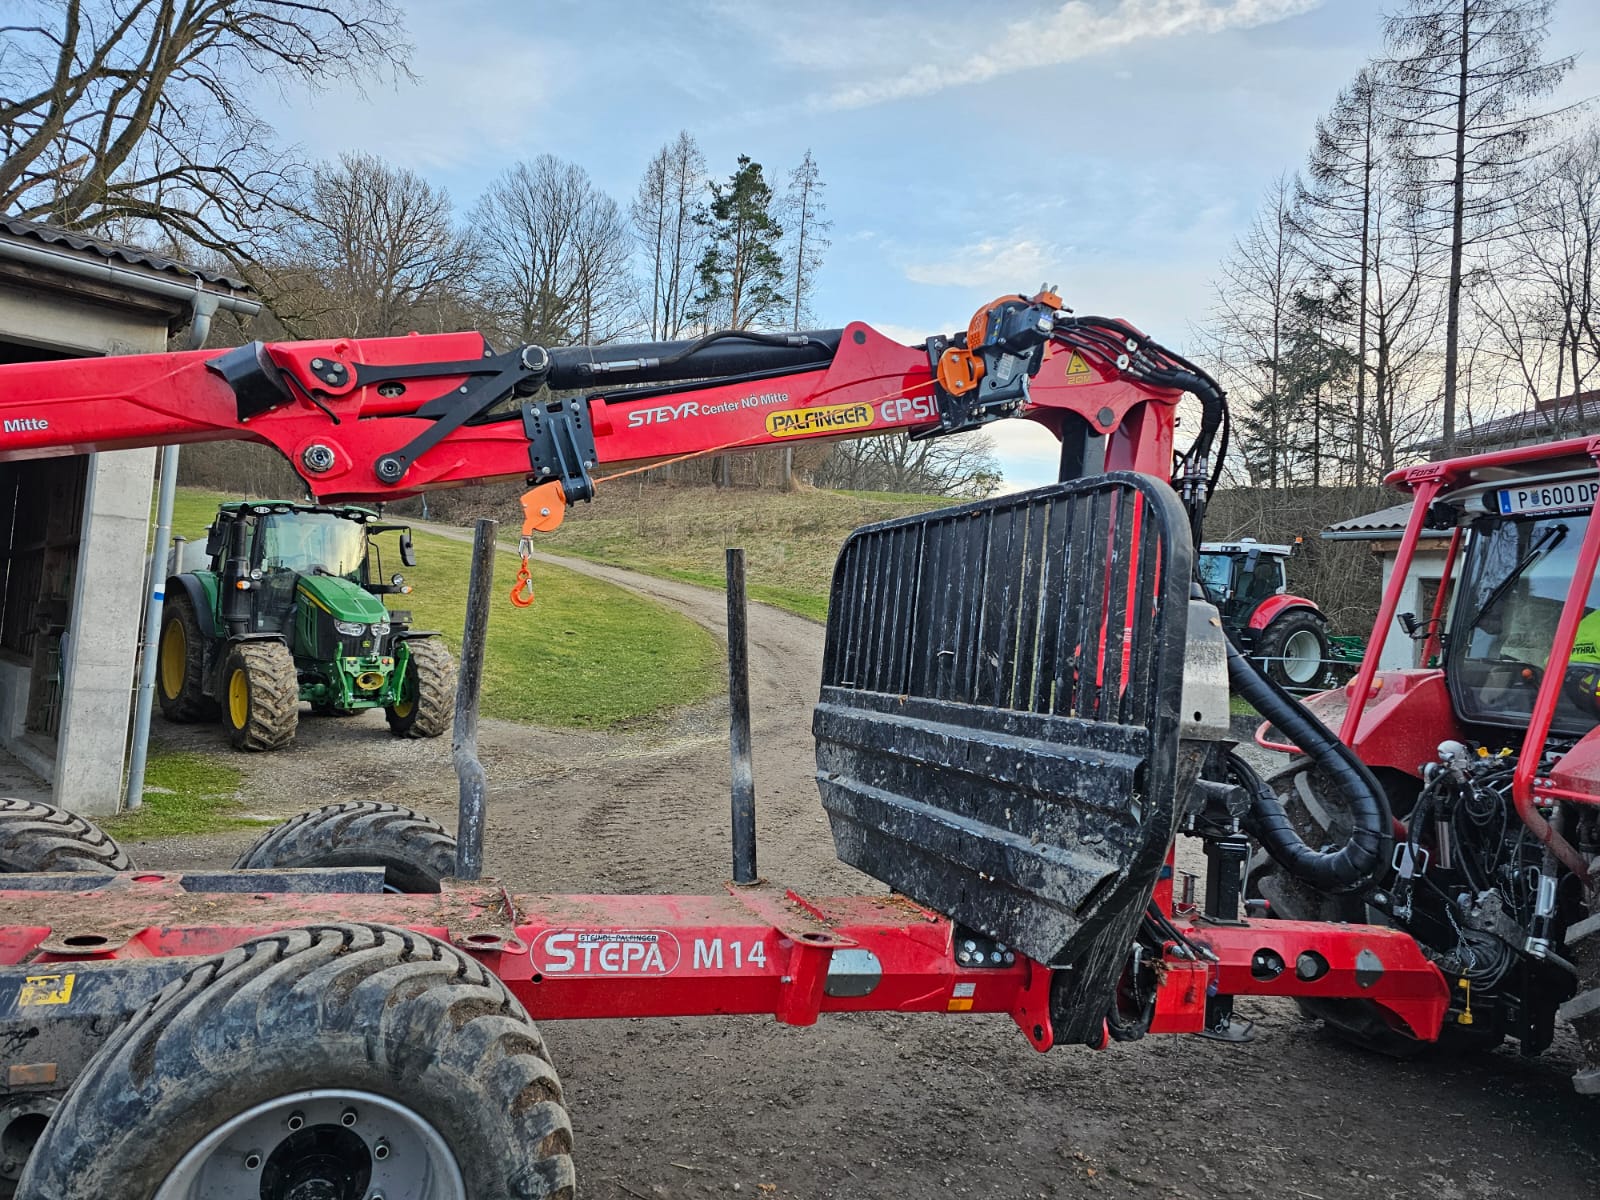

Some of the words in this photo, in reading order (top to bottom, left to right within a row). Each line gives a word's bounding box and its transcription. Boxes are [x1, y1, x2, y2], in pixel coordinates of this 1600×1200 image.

[627, 401, 699, 428] STEYR
[701, 401, 739, 415] Center
[741, 393, 759, 408] NÖ
[760, 392, 789, 405] Mitte
[772, 406, 868, 431] PALFINGER
[881, 394, 940, 422] EPSI
[3, 418, 49, 433] Mitte
[1409, 466, 1440, 477] Forst
[1518, 491, 1528, 509] P
[1541, 486, 1575, 506] 600
[545, 933, 666, 972] STEPA
